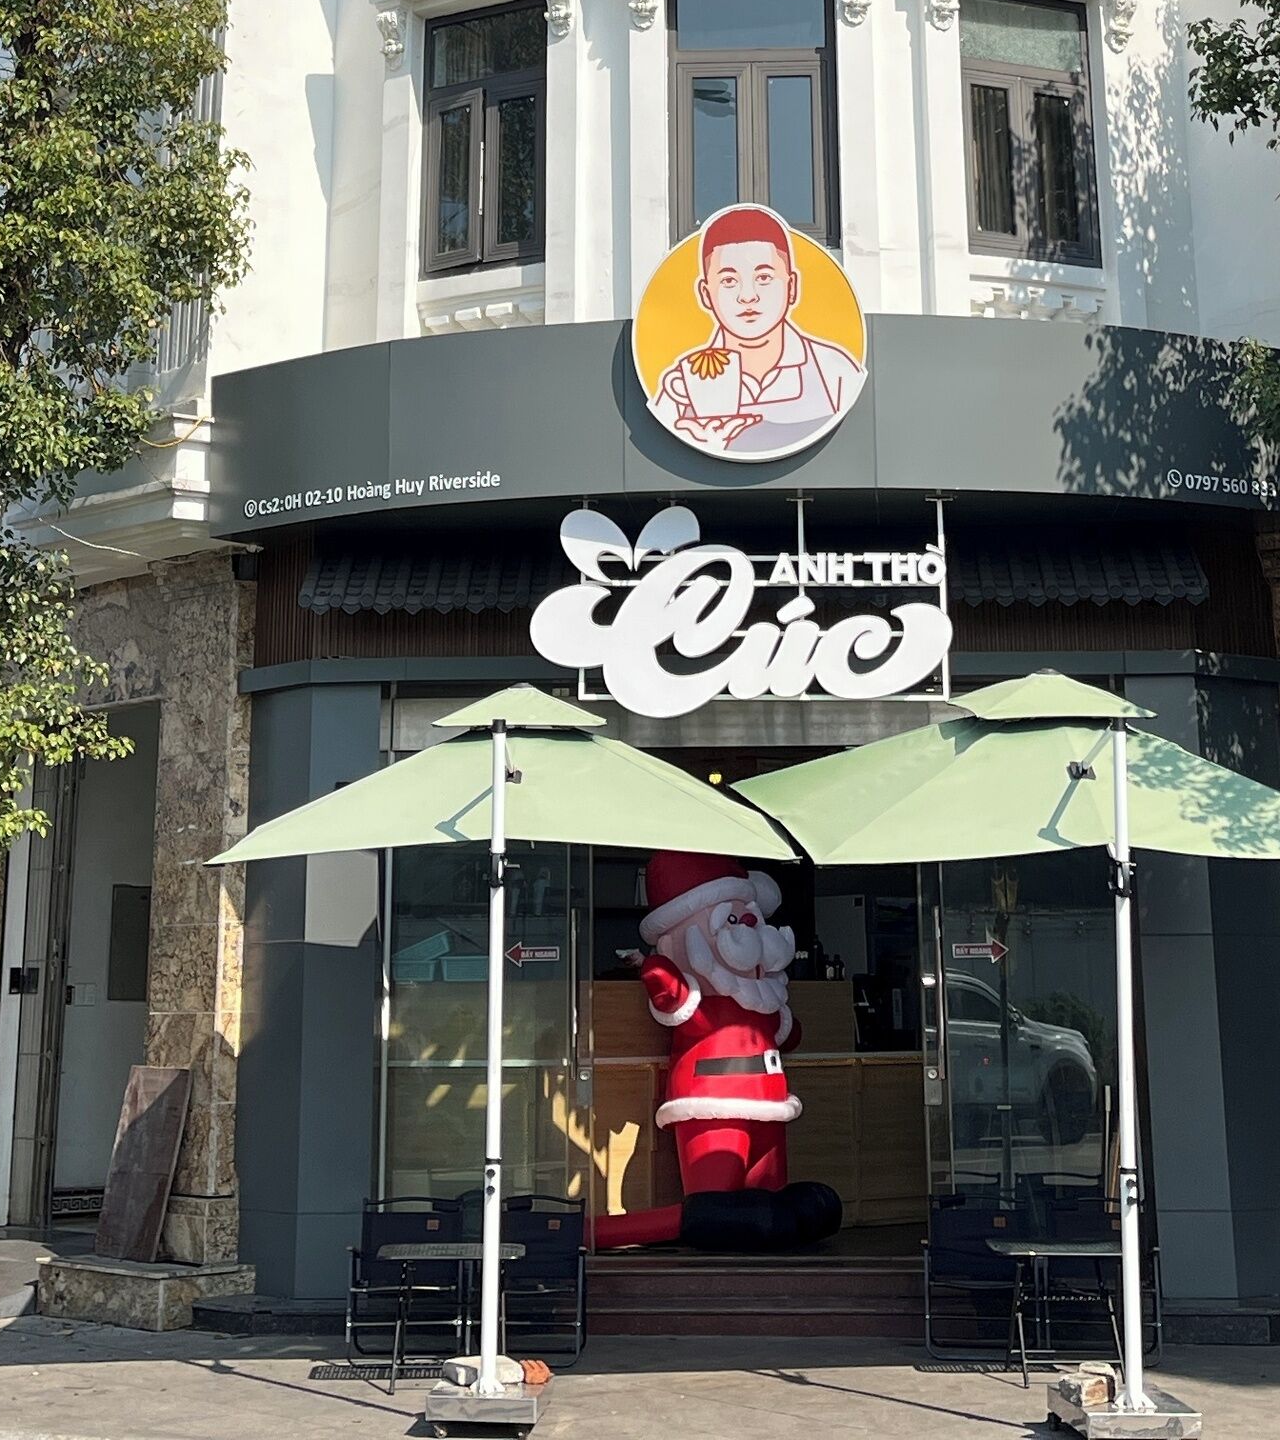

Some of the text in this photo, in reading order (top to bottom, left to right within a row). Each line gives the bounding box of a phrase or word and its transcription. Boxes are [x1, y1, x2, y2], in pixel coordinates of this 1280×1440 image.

[305, 487, 343, 507] 02-10
[347, 480, 392, 501] Hoàng
[395, 478, 425, 496] Huy
[429, 471, 501, 491] Riverside
[1184, 473, 1220, 492] 0797
[1222, 477, 1249, 495] 560
[768, 552, 854, 586] ANH
[530, 544, 953, 718] Cúc
